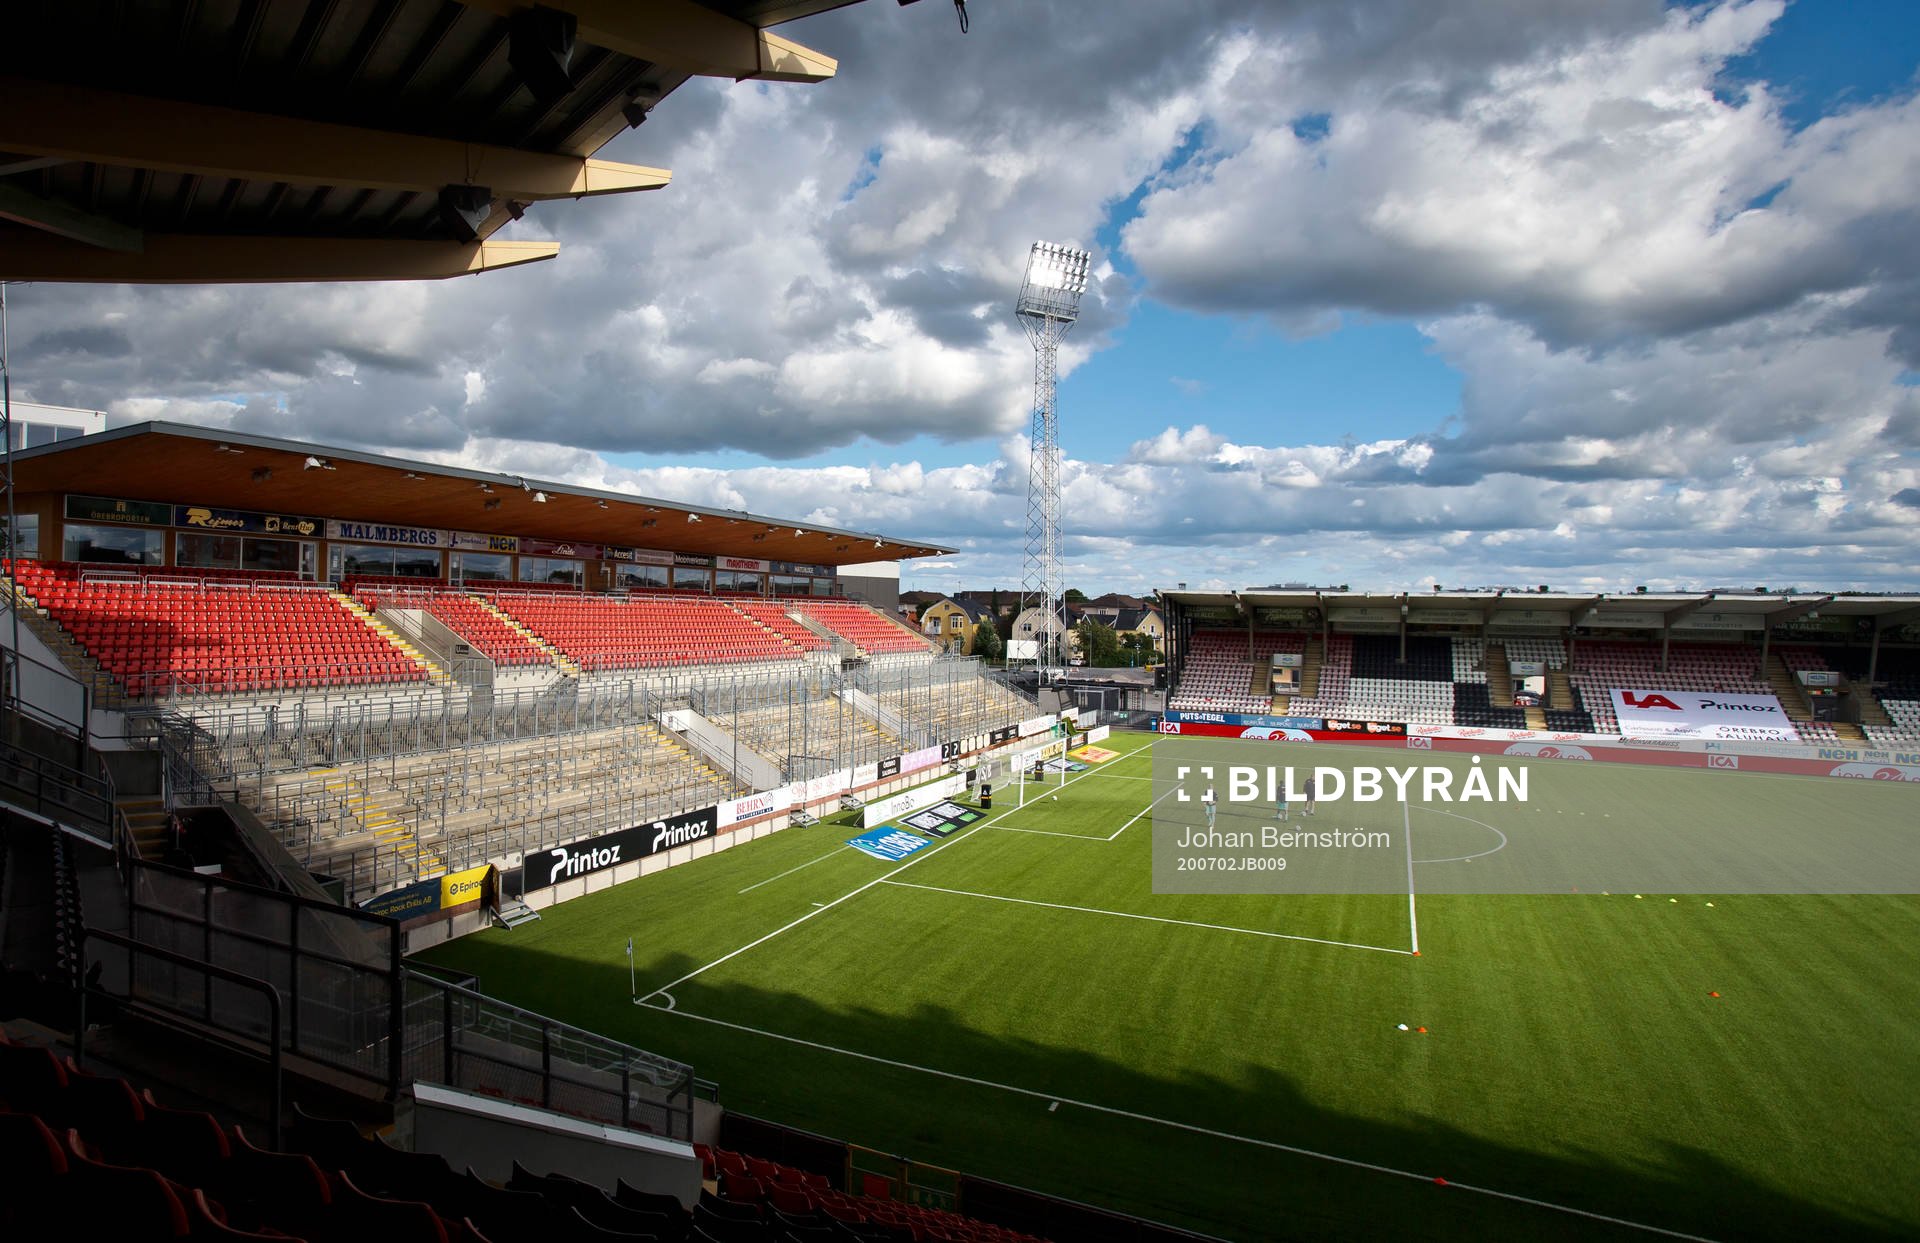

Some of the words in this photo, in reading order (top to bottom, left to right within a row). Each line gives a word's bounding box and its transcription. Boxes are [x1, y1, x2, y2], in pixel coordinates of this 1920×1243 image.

[340, 523, 437, 545] MALMBERGS
[1698, 699, 1778, 713] Printoz
[1161, 722, 1178, 733] ICA
[1409, 737, 1429, 748] ICA
[1710, 755, 1736, 768] ICA
[736, 797, 765, 815] BEHRN
[653, 820, 708, 853] Printoz
[551, 845, 620, 884] Printoz
